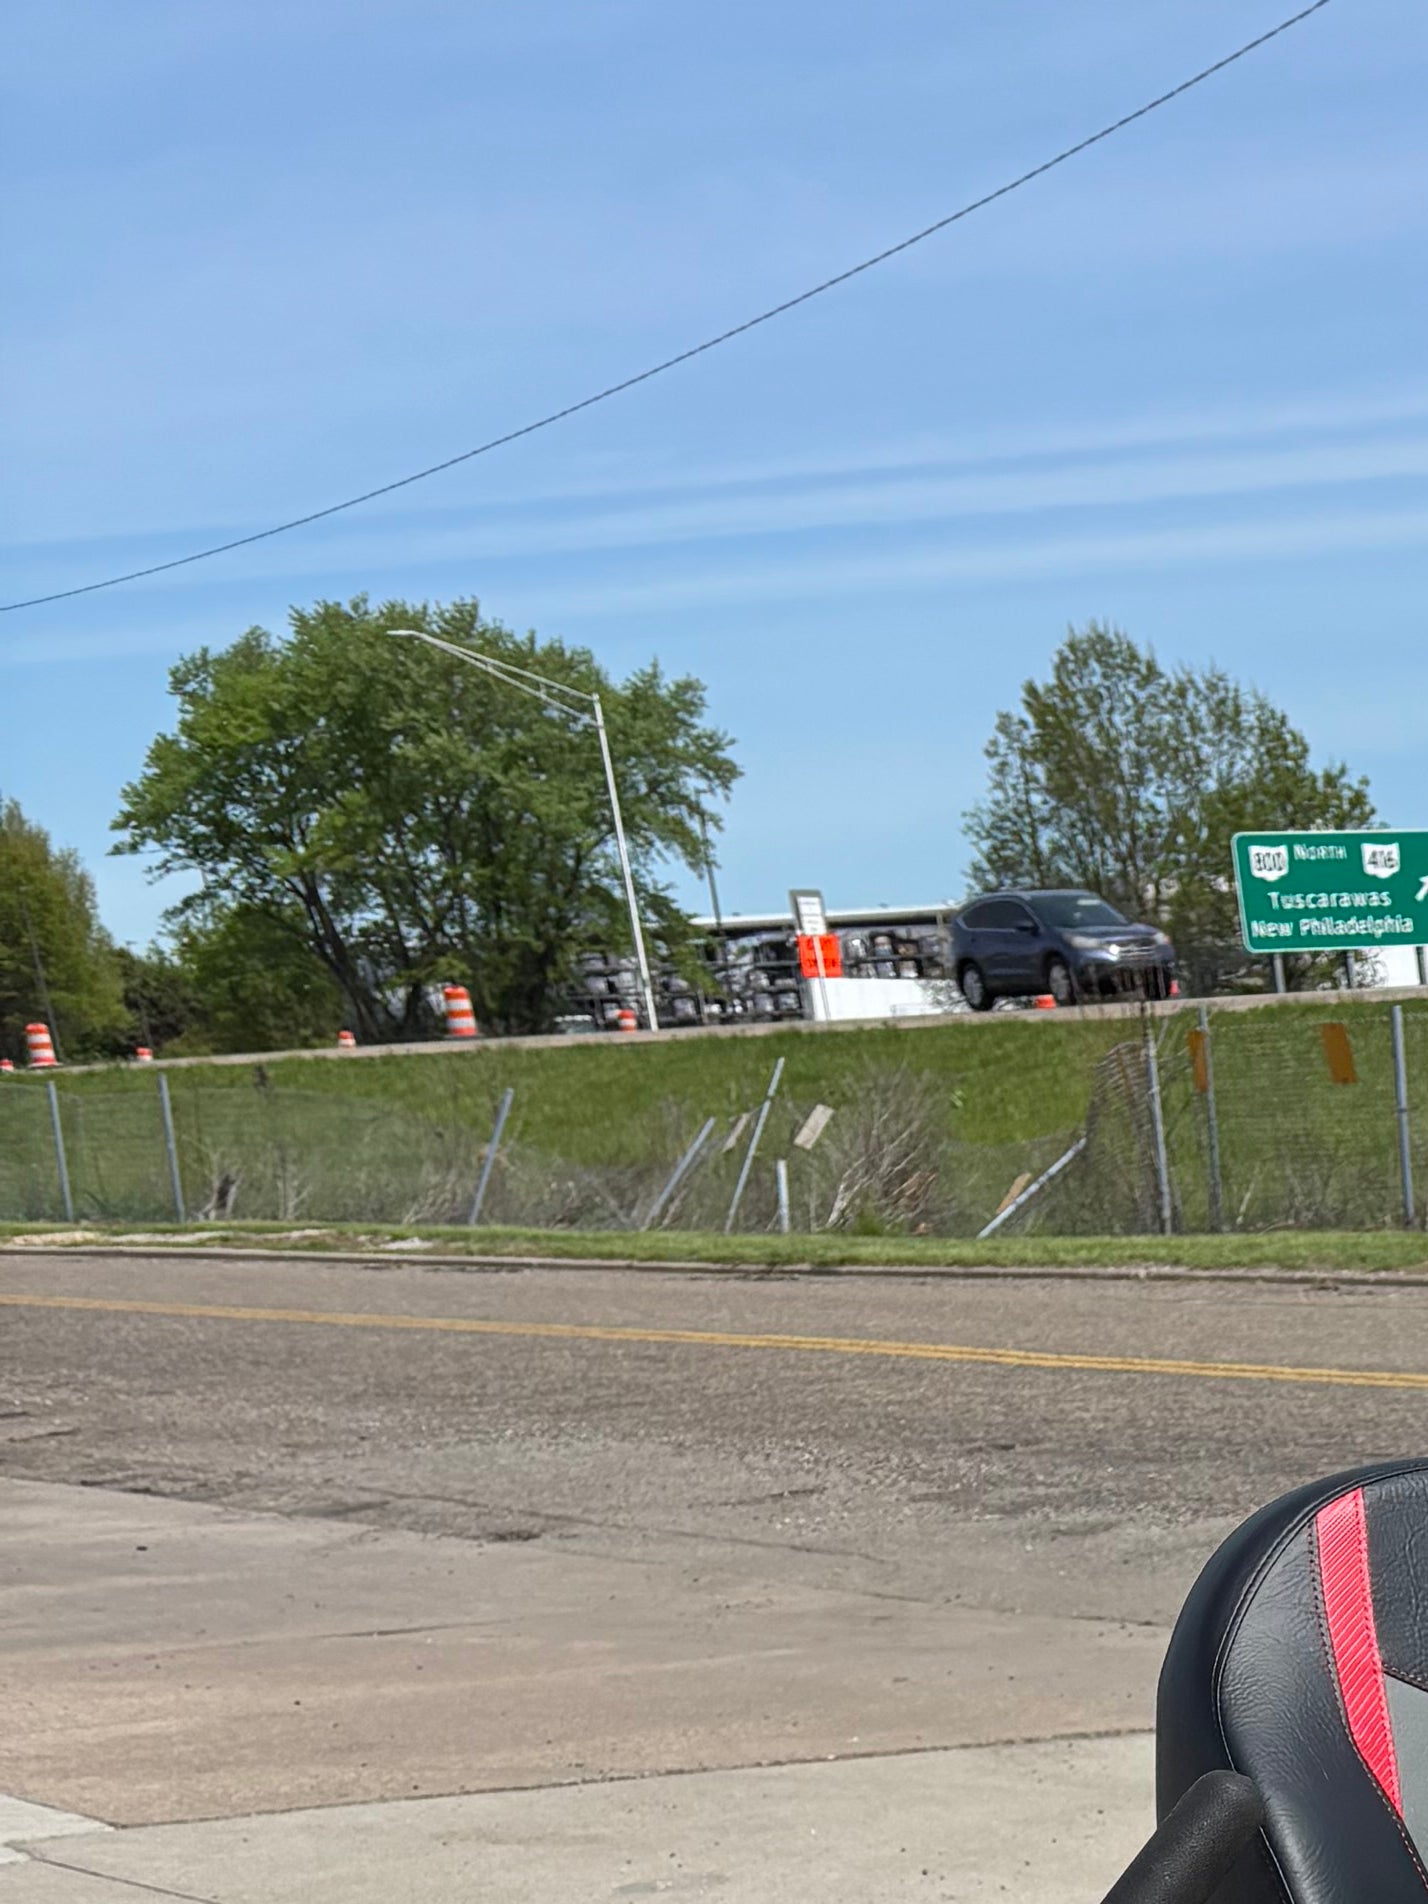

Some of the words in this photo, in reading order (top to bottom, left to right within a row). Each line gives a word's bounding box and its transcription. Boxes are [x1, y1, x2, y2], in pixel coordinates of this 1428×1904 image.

[1267, 891, 1392, 910] Tuscarawas
[1251, 920, 1293, 938] New
[1299, 914, 1414, 938] Philadelphia
